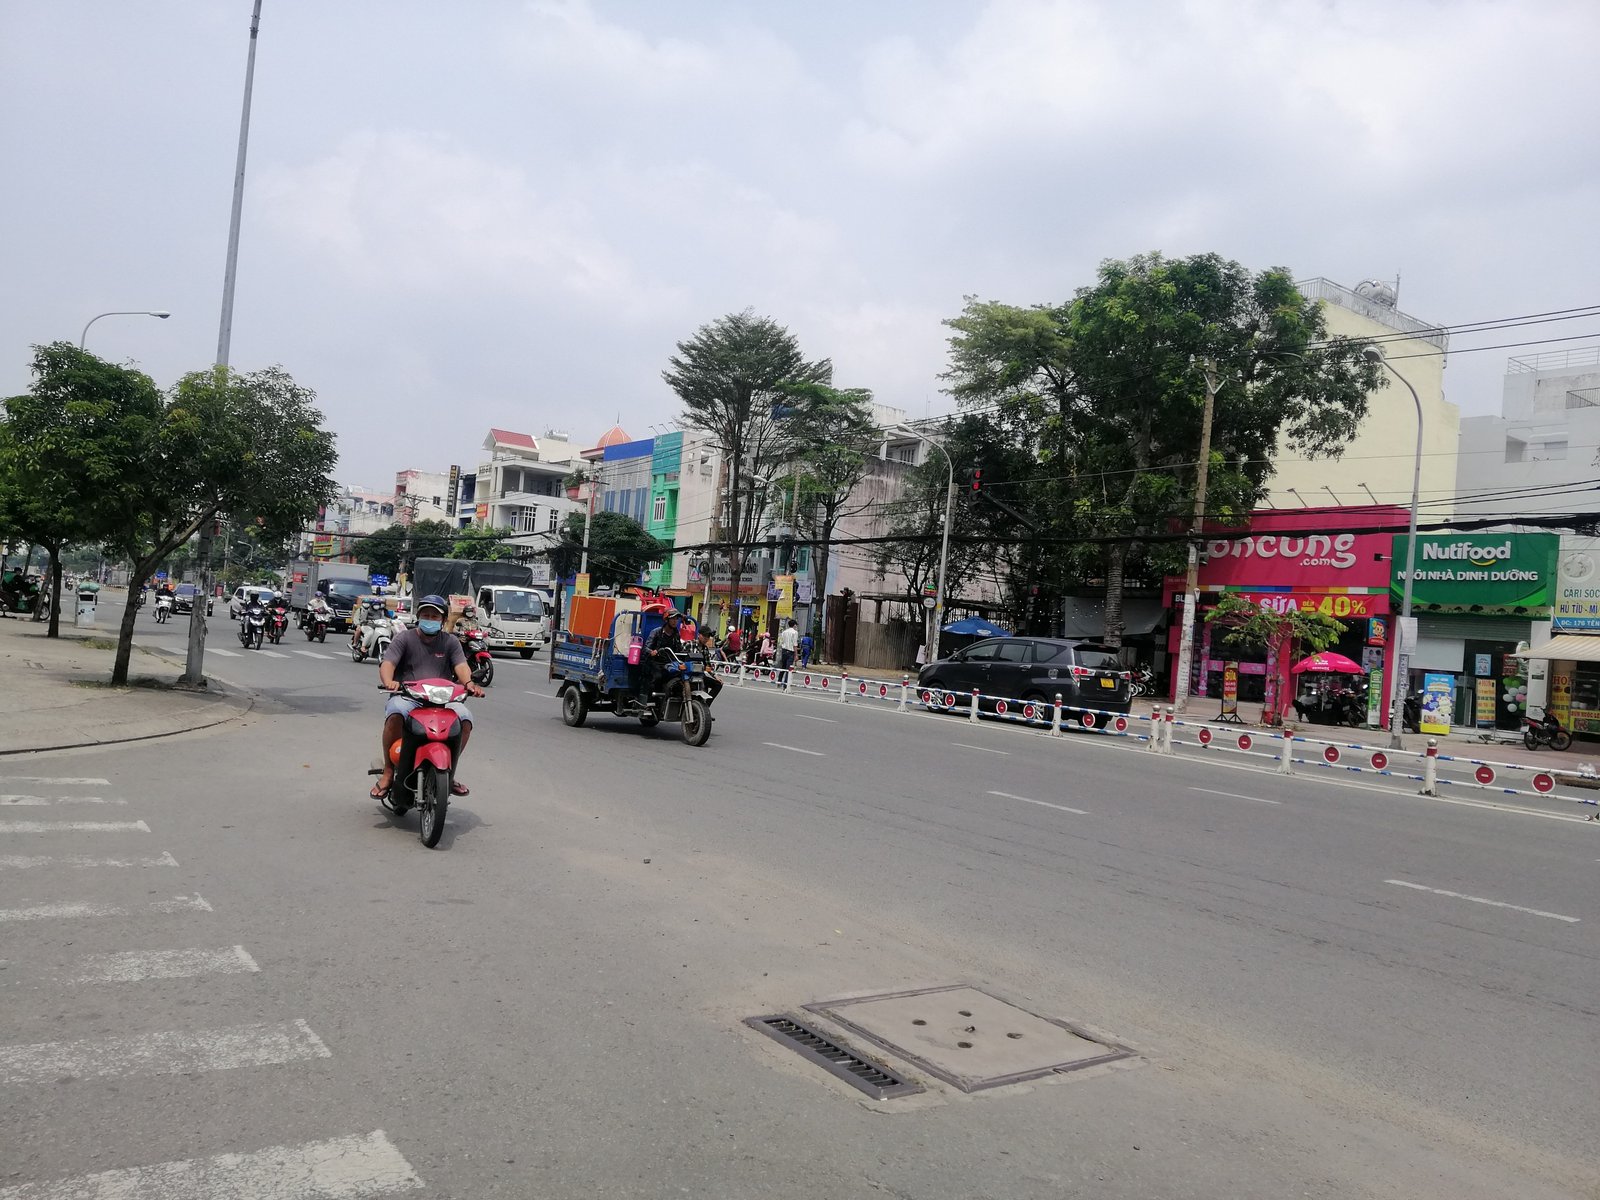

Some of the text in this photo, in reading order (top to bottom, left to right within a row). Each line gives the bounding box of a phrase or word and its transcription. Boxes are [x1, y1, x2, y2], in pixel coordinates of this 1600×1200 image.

[1206, 534, 1356, 569] oncung
[1423, 541, 1511, 560] Nutifood
[1397, 569, 1538, 581] NÔI NHÀ DINH DƯỠNG
[1317, 596, 1367, 617] 40%
